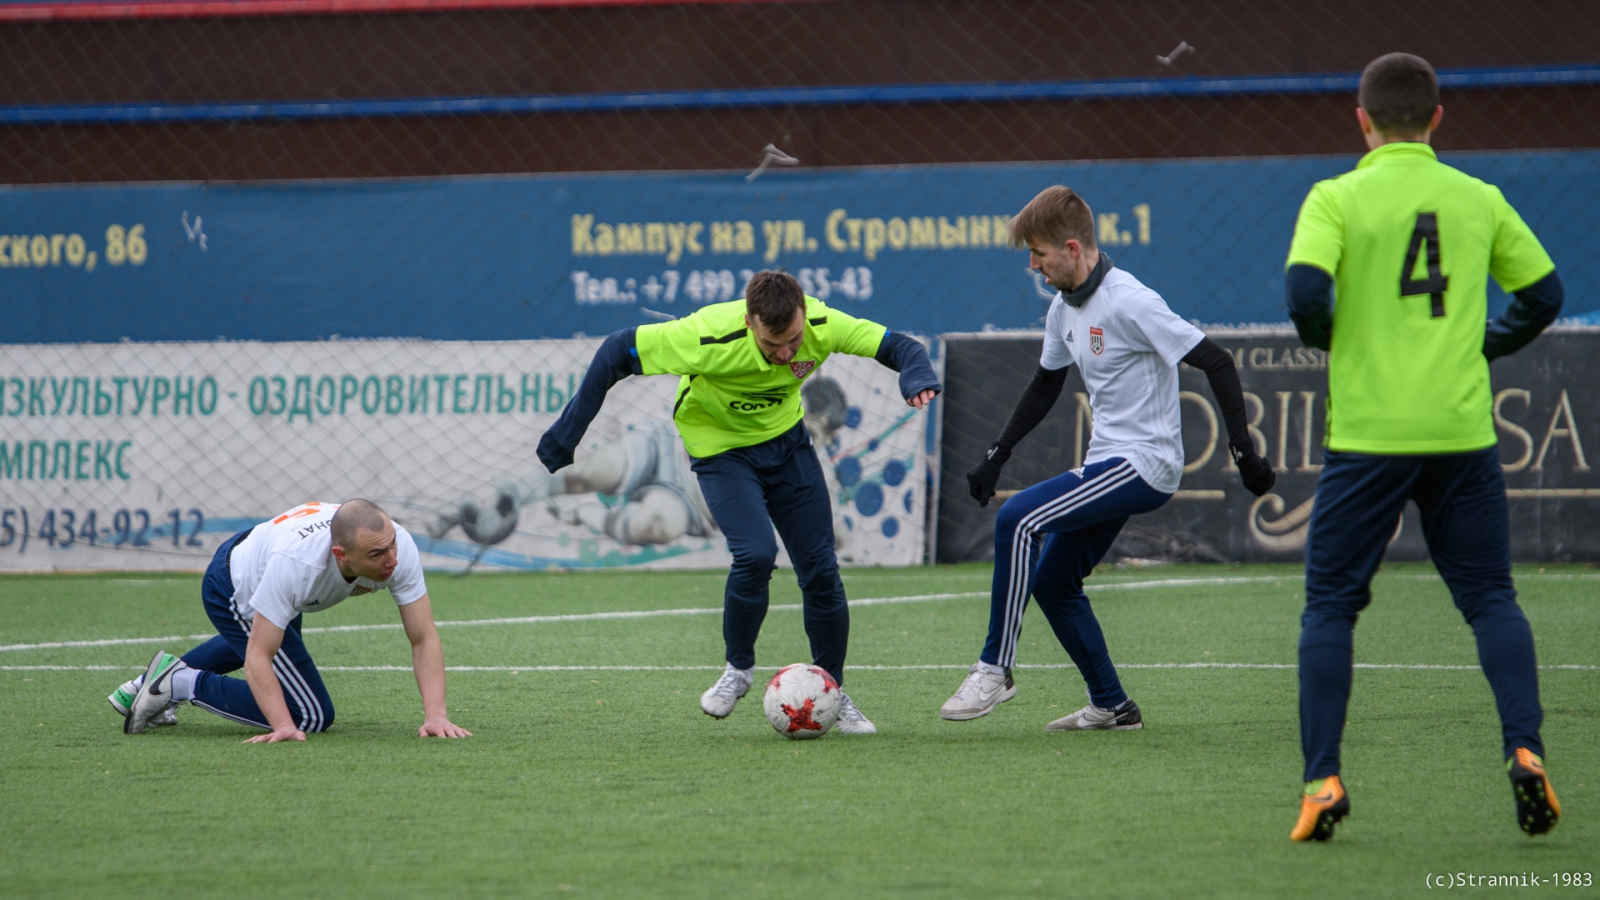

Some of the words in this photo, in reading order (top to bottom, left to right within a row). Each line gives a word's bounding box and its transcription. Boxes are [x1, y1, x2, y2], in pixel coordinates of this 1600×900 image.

[105, 223, 148, 267] 86
[571, 213, 705, 265] Кампус
[710, 220, 756, 254] на
[761, 219, 818, 263] ул.
[824, 207, 1028, 261] Стромынк
[684, 269, 736, 302] 499
[1399, 210, 1450, 318] 4
[1251, 346, 1332, 370] CLASSI
[0, 374, 219, 417] ЗКУЛЬТУРНО
[248, 363, 587, 423] ОЗДОРОВИТЕЛЬНЫ
[0, 440, 133, 480] МПЛЕКС
[38, 506, 206, 548] 434-92-12
